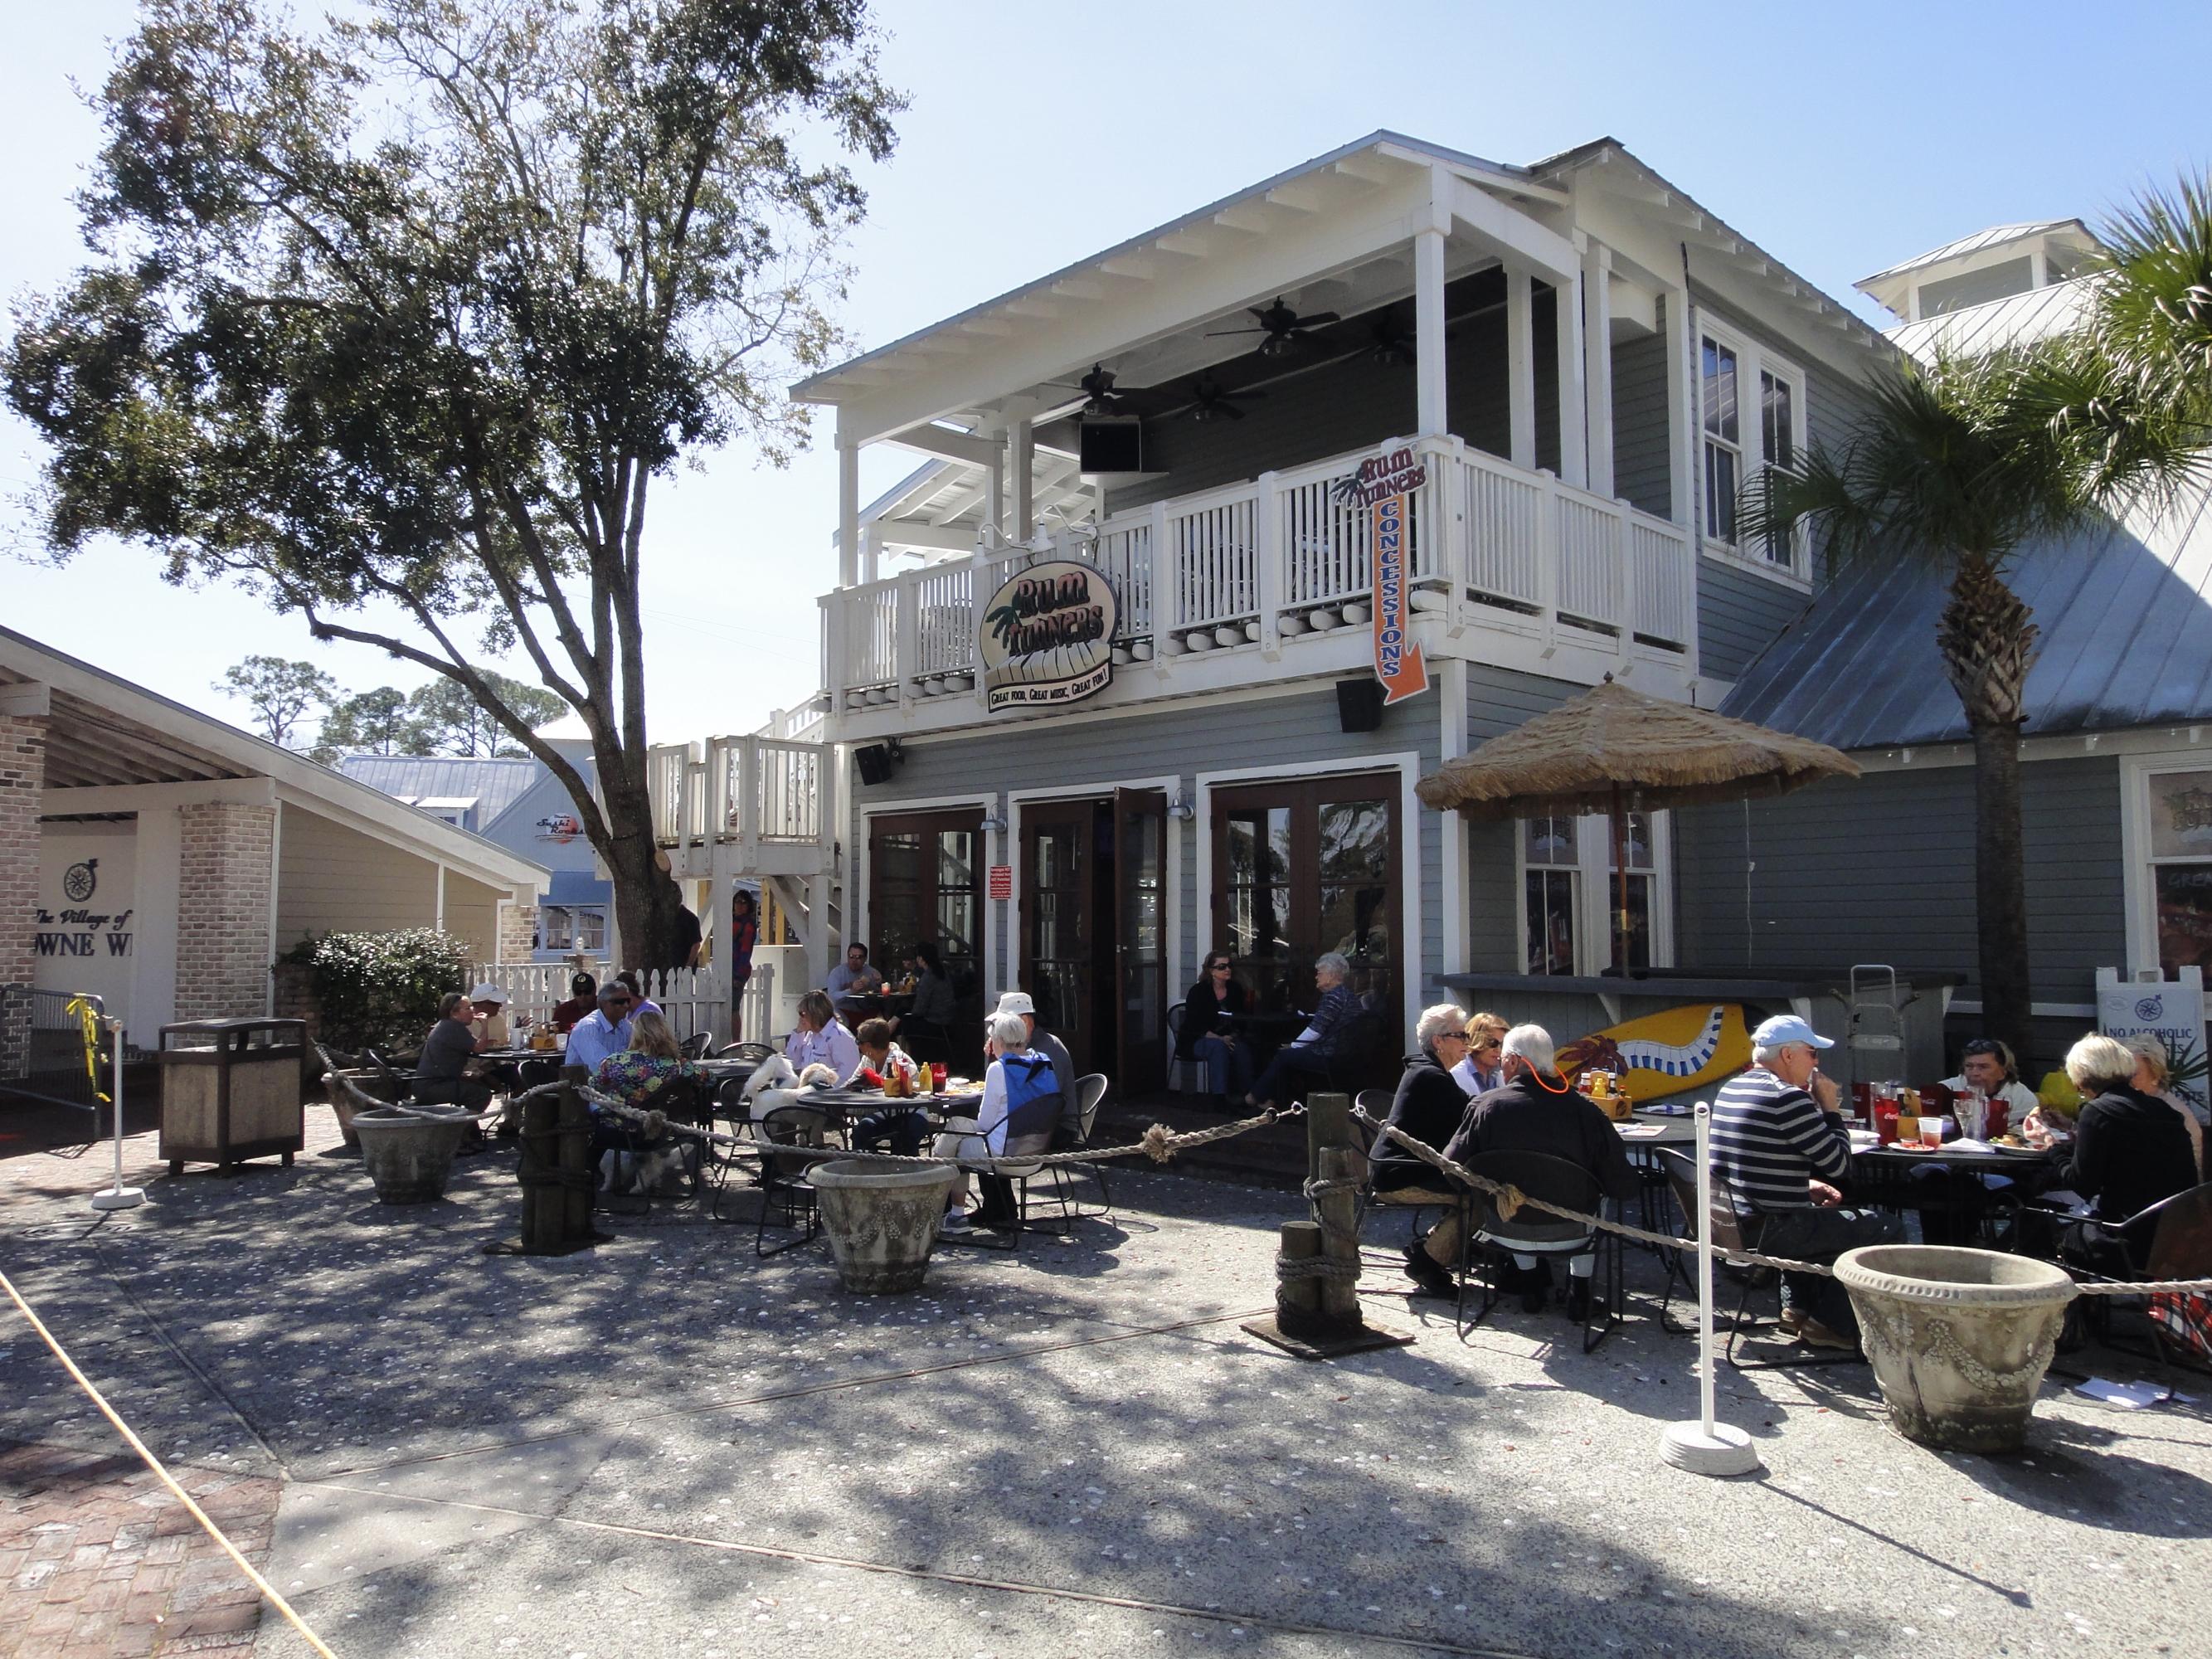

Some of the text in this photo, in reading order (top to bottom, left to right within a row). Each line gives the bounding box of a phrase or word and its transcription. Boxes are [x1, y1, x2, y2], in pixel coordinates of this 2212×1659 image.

[1379, 500, 1402, 677] CONCESSIONS
[537, 818, 570, 827] Sushi
[36, 909, 133, 931] The Village of
[36, 933, 133, 956] WNE W
[2110, 1029, 2126, 1038] NO
